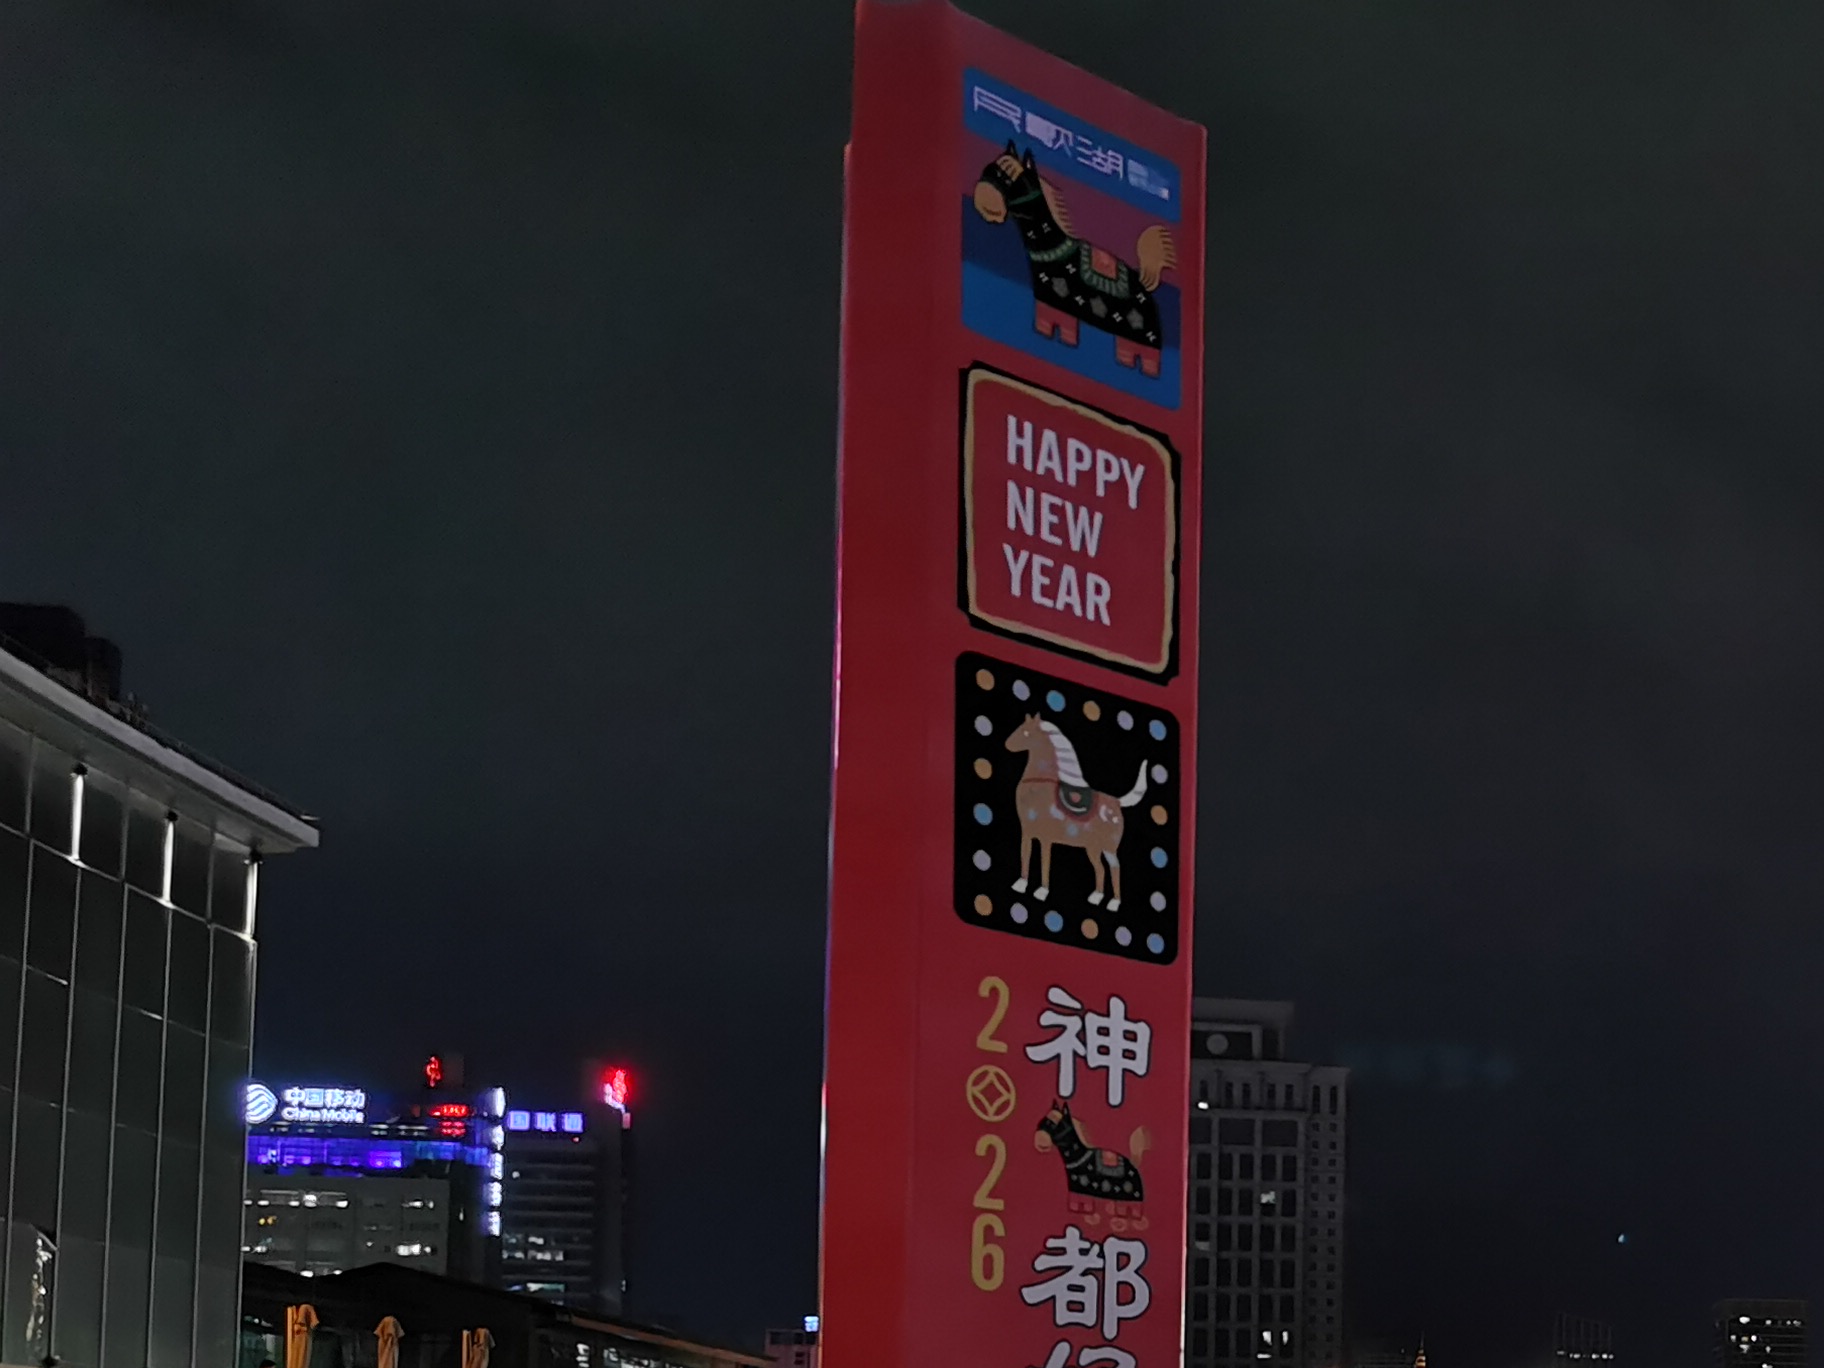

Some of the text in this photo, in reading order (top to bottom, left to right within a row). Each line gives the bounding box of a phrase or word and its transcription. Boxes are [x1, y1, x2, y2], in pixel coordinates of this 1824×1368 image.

[1006, 414, 1145, 509] HAPPY
[1006, 481, 1102, 557] NEW
[1002, 543, 1111, 625] YEAR
[284, 1087, 365, 1109] 中国移动
